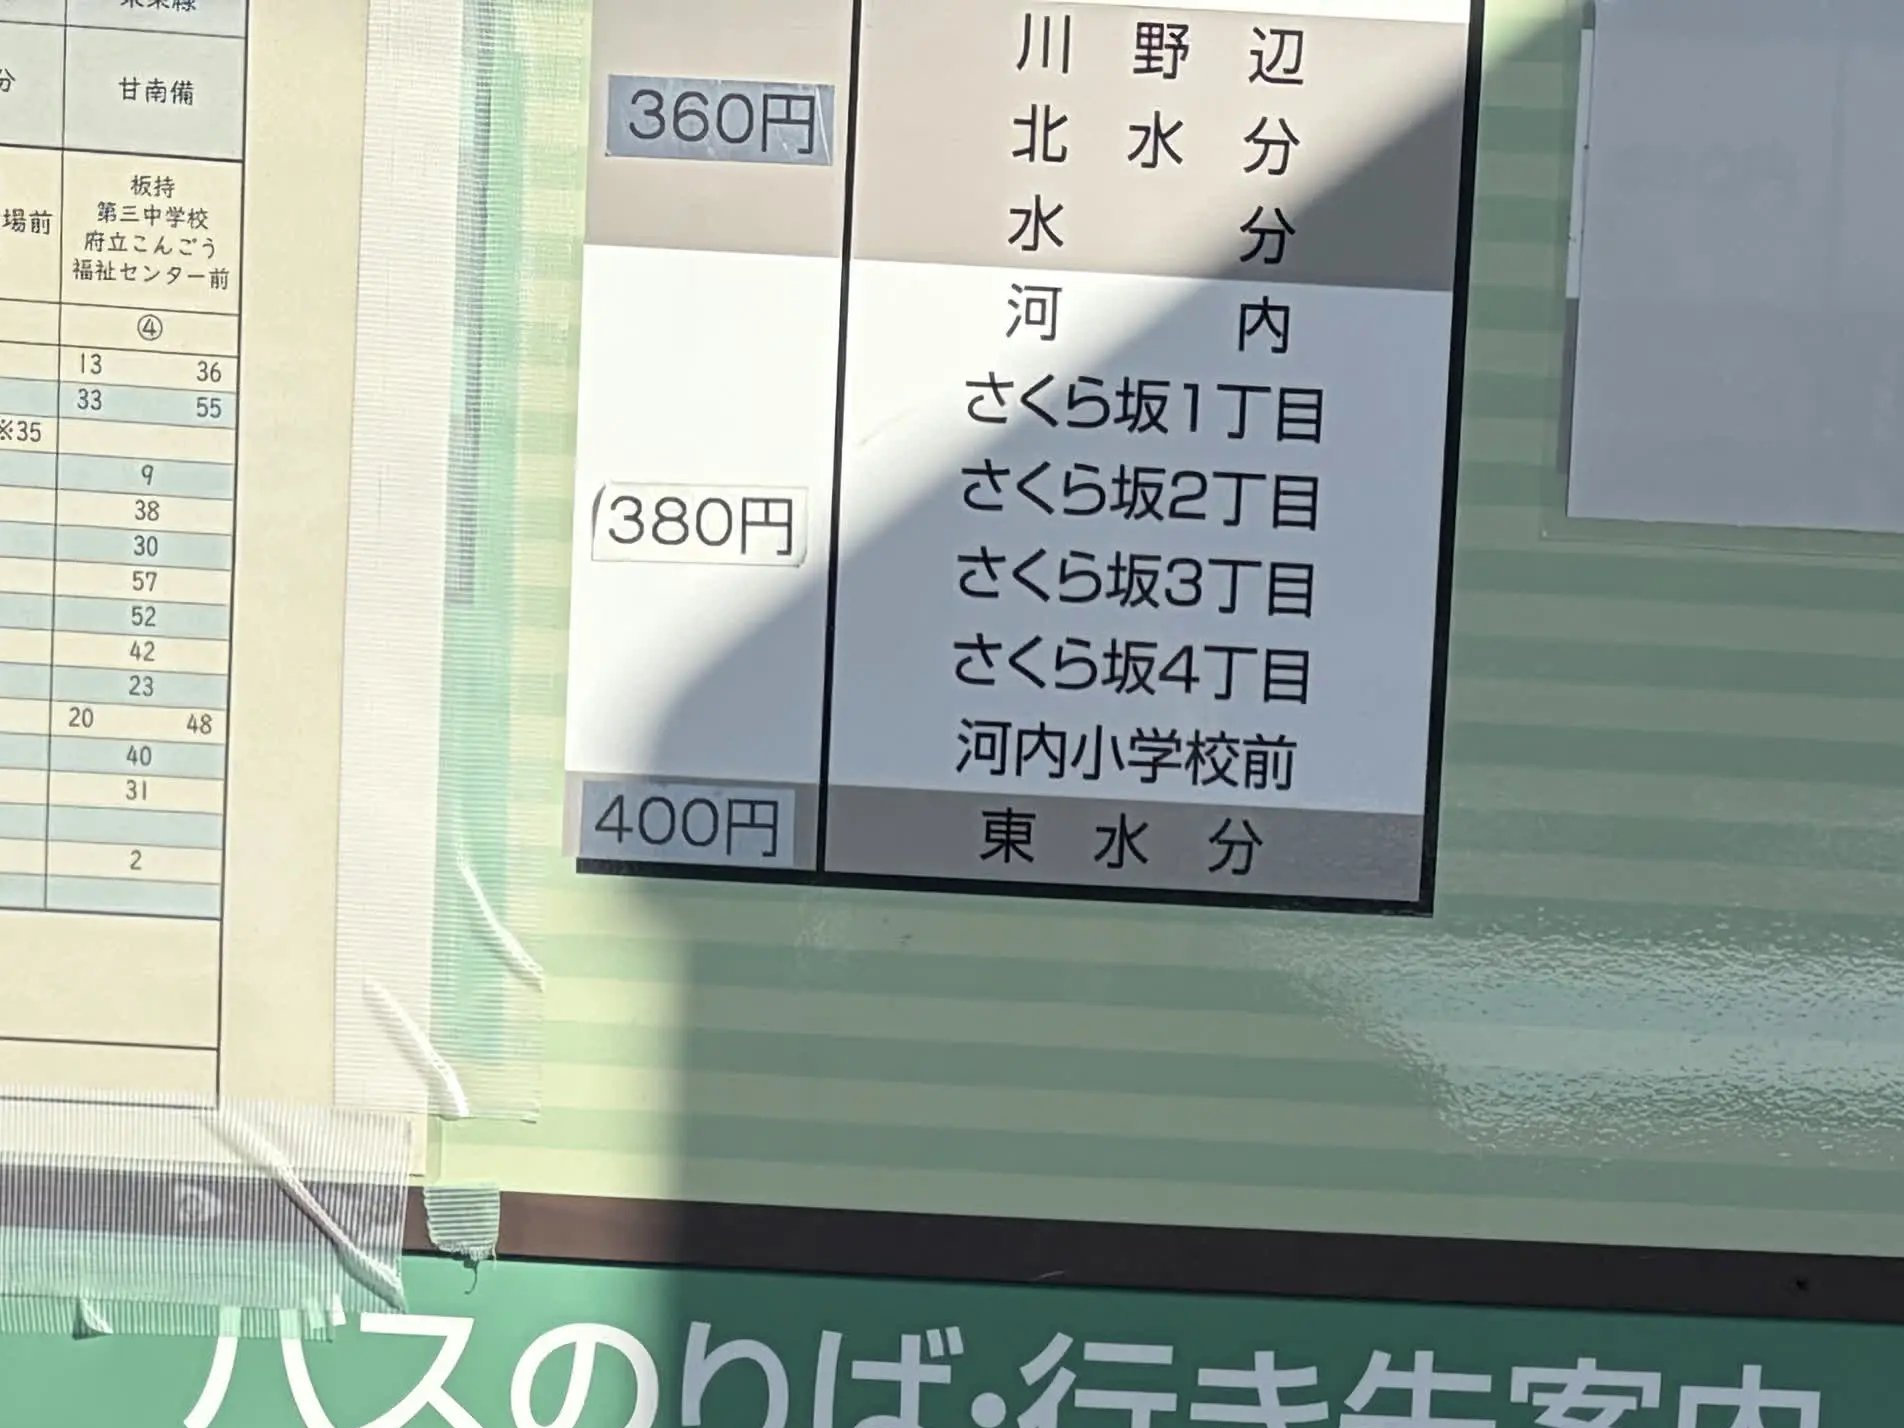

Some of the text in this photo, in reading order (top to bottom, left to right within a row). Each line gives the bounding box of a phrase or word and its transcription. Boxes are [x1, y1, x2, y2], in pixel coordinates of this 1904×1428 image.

[118, 76, 195, 106] 甘南備
[625, 85, 818, 156] 360円
[130, 174, 176, 199] 板持
[97, 200, 209, 230] 第三中学校
[83, 231, 218, 261] 府立こんごう
[71, 257, 230, 291] 福祉センター前
[80, 352, 103, 375] 13
[196, 359, 222, 383] 36
[76, 387, 103, 411] 33
[196, 396, 222, 419] 55
[965, 371, 1324, 445] さくら坂1丁目
[140, 463, 155, 486] 9
[961, 457, 1319, 532] さくら坂2丁目
[134, 498, 160, 522] 38
[607, 492, 796, 558] 380円
[133, 534, 159, 558] 30
[132, 570, 158, 592] 57
[957, 545, 1315, 619] さくら坂3丁目
[131, 605, 157, 628] 52
[129, 639, 156, 662] 42
[953, 632, 1310, 705] さくら坂4丁目
[128, 674, 154, 697] 23
[68, 705, 94, 729] 20
[186, 713, 213, 736] 48
[126, 744, 152, 767] 40
[955, 717, 1298, 791] 河内小学校前
[125, 779, 147, 801] 31
[594, 794, 781, 858] 400円
[129, 848, 142, 871] 2
